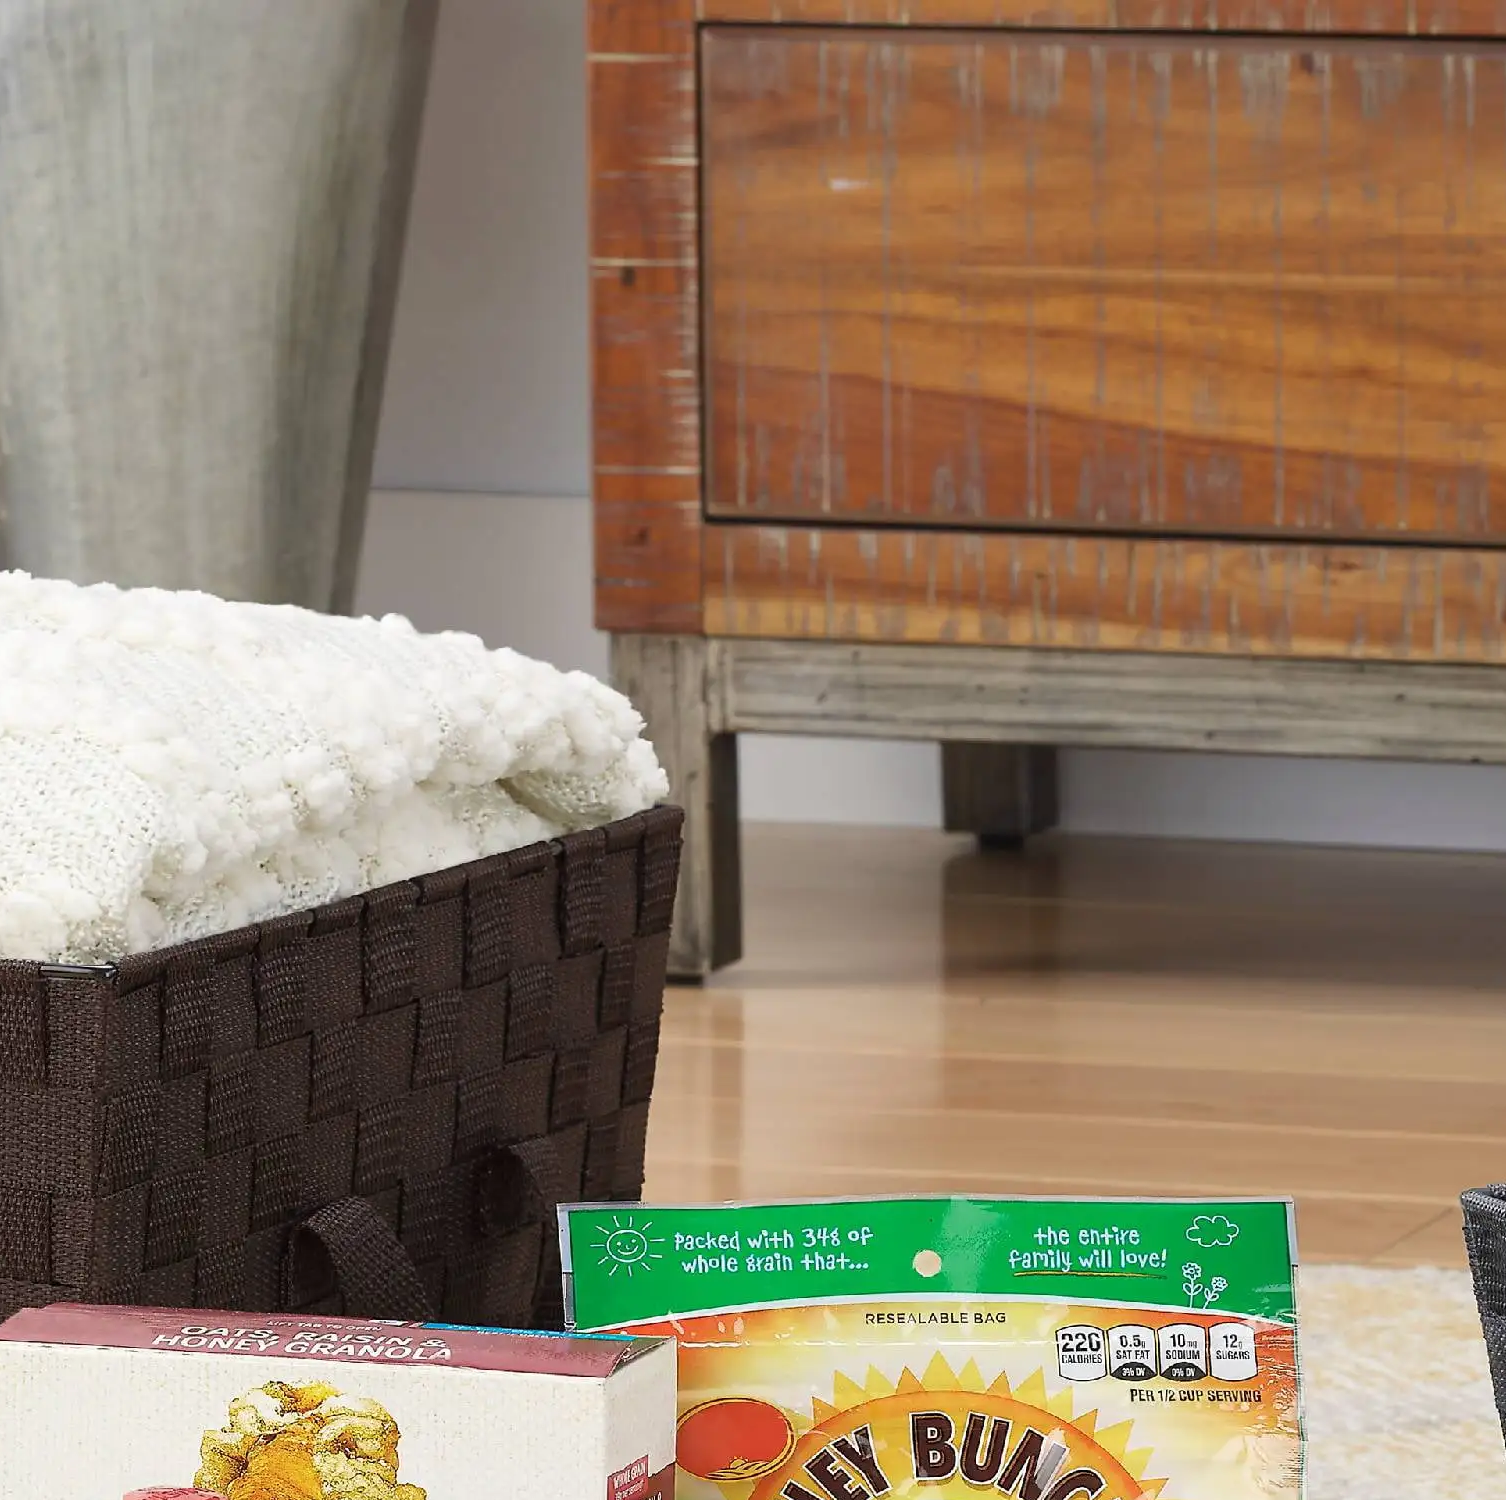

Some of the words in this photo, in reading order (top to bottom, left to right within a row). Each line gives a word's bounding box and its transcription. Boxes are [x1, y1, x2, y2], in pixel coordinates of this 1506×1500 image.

[746, 1229, 795, 1250] with
[801, 1227, 842, 1249] 34g
[847, 1227, 875, 1247] of
[1032, 1225, 1071, 1247] the
[1078, 1225, 1141, 1247] entire
[680, 1252, 739, 1274] whole
[744, 1252, 794, 1273] grain
[799, 1250, 870, 1272] that...
[1008, 1248, 1073, 1274] family
[1077, 1247, 1113, 1269] will
[1119, 1247, 1168, 1270] love!
[865, 1311, 970, 1325] RESEALABLE
[973, 1311, 1007, 1325] BAG
[296, 1321, 324, 1330] TAB
[323, 1322, 343, 1331] TO
[344, 1324, 383, 1332] OPEN
[180, 1326, 280, 1342] OATS,
[292, 1331, 414, 1347] RAISIN
[419, 1339, 447, 1349] &
[151, 1333, 280, 1353] HONEY
[283, 1341, 453, 1362] GRANOLA
[1061, 1353, 1103, 1365] CALORIES
[1116, 1349, 1133, 1361] SAT
[1135, 1349, 1151, 1361] FAT
[1165, 1349, 1201, 1361] SODIUM
[1215, 1350, 1251, 1361] SUGARS
[1135, 1366, 1147, 1378] DV
[1185, 1367, 1197, 1378] DV
[1130, 1388, 1156, 1403] PER
[1157, 1389, 1177, 1402] 1/2
[1178, 1389, 1204, 1403] CUP
[1207, 1388, 1263, 1403] SERVING
